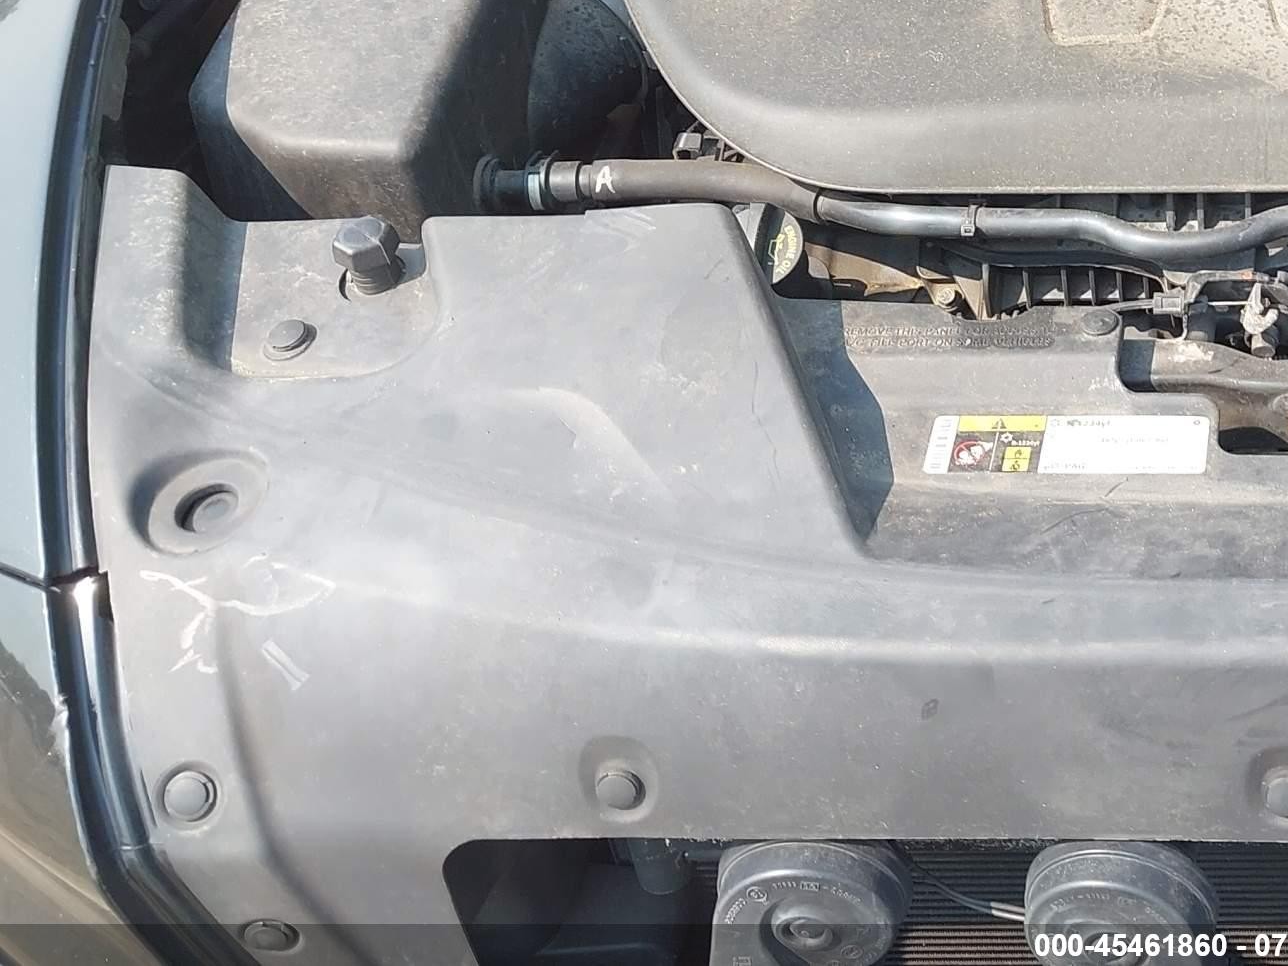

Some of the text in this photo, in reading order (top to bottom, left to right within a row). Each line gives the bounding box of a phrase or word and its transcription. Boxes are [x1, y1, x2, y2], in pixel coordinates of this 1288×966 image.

[595, 165, 617, 194] A
[775, 225, 798, 274] ENGINE OIL
